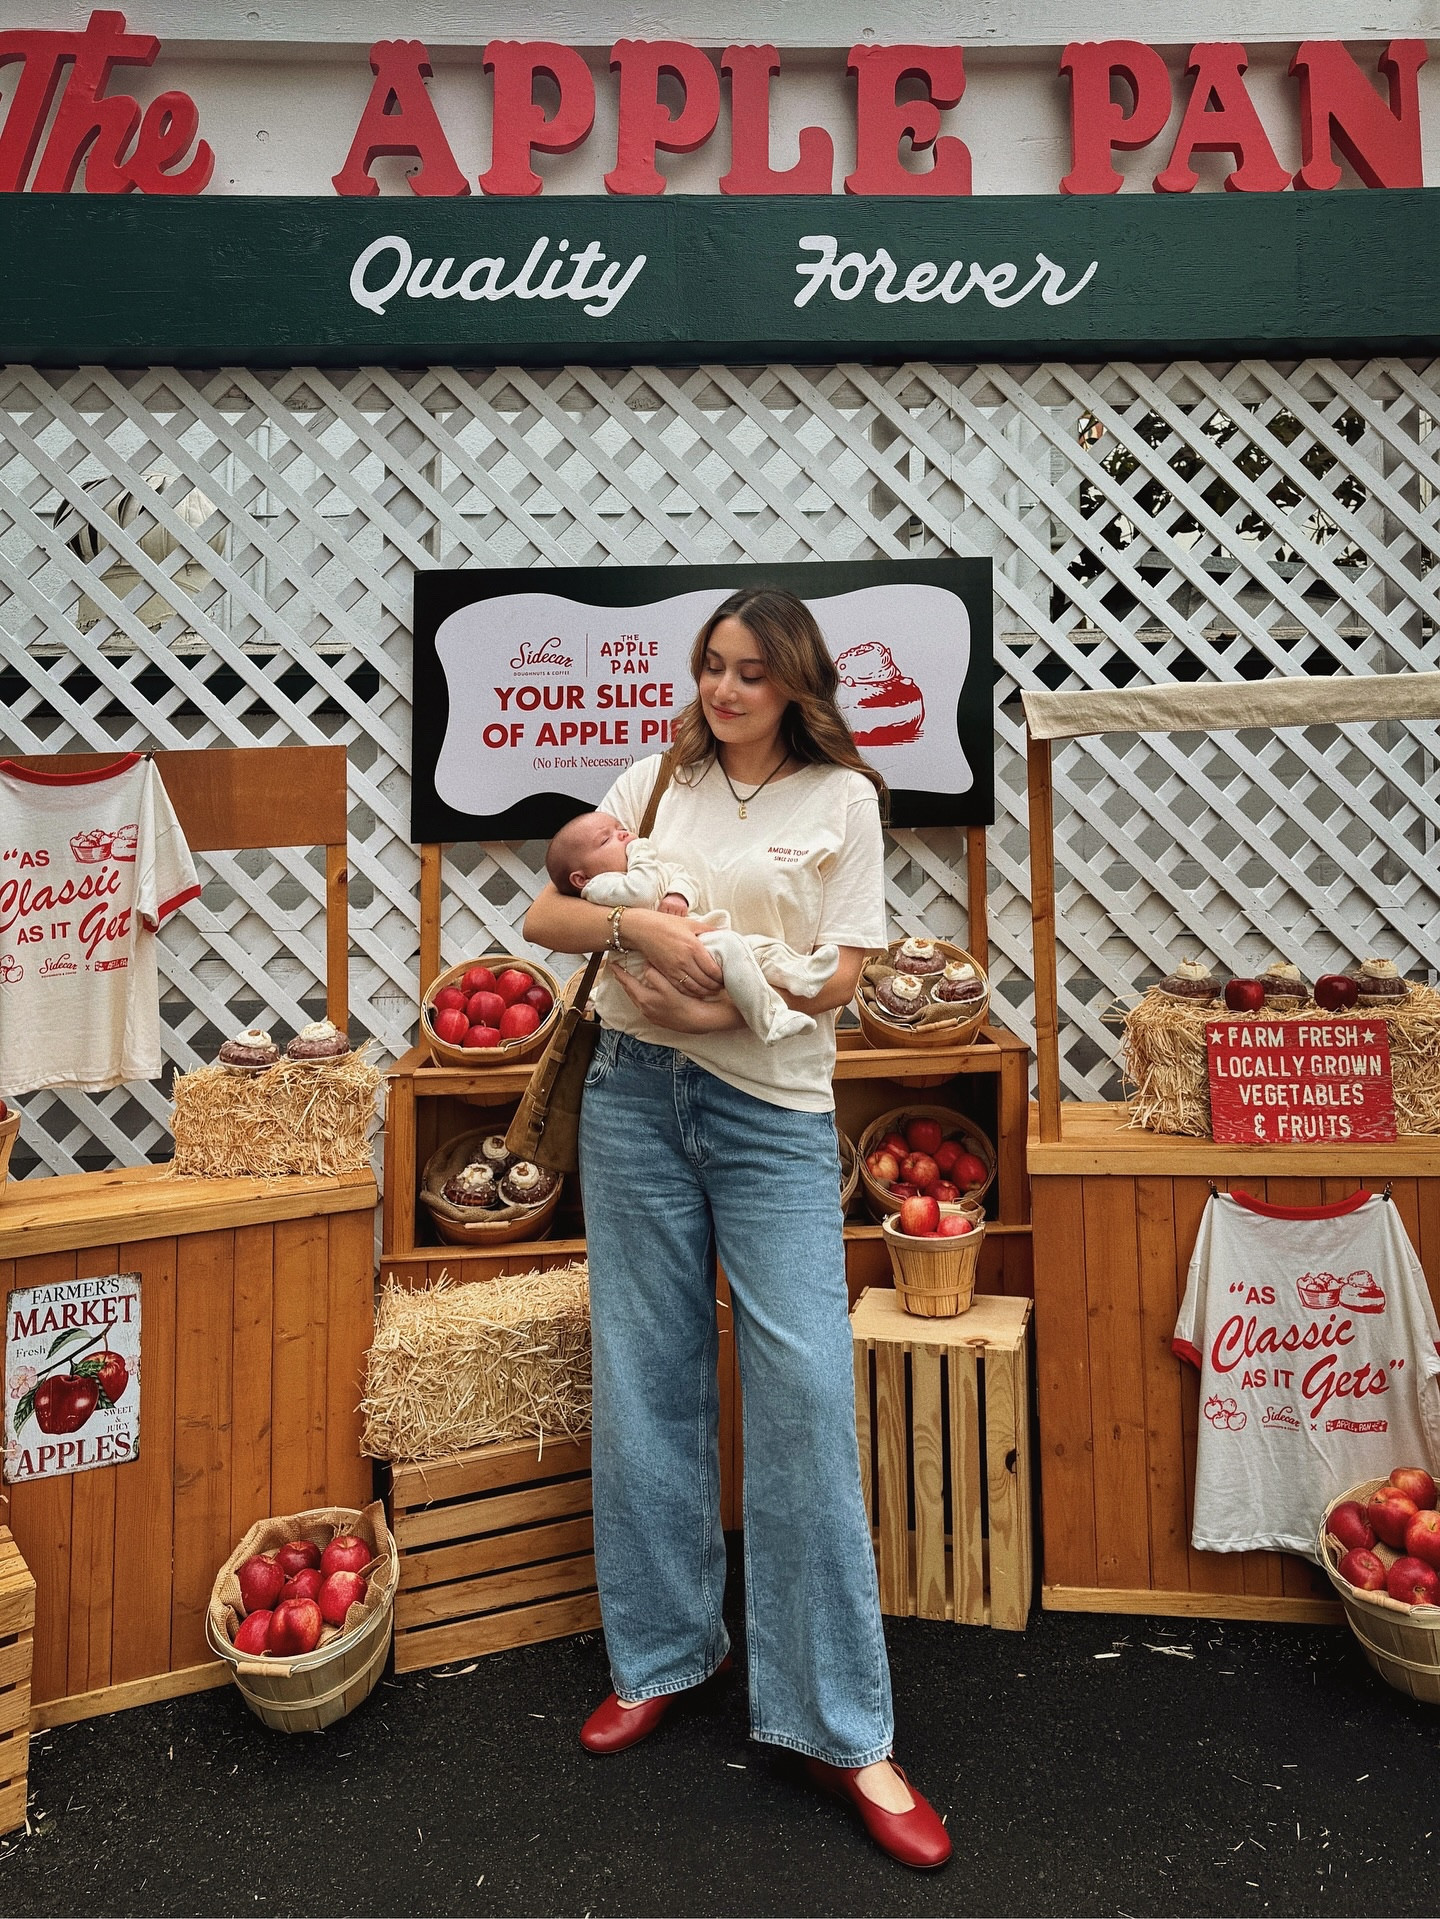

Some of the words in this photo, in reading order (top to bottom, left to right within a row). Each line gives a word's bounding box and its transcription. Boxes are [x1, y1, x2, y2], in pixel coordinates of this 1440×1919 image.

[0, 10, 215, 194] The
[332, 39, 972, 196] APPLE
[1058, 39, 1428, 195] PAN
[350, 236, 646, 317] Quality
[794, 235, 1098, 308] Forever
[510, 637, 573, 669] Sidecar
[601, 641, 658, 657] APPLE
[611, 659, 649, 674] PAN
[494, 686, 585, 711] YOUR
[597, 683, 673, 708] SLICE
[483, 723, 524, 748] OF
[535, 721, 629, 746] APPLE
[533, 756, 551, 770] (No
[554, 756, 577, 768] Fork
[580, 754, 634, 770] Necessary)
[768, 846, 792, 855] AMOUR
[17, 925, 44, 945] AS
[51, 921, 71, 940] IT
[78, 902, 131, 960] Get
[39, 953, 77, 974] Sidecar
[1227, 1026, 1284, 1048] FARM
[1298, 1025, 1358, 1048] FRESH
[1216, 1055, 1305, 1078] LOCALLY
[1311, 1054, 1382, 1077] GROWN
[1238, 1083, 1365, 1107] VEGETABLES
[1277, 1115, 1351, 1138] FRUITS
[31, 1279, 120, 1305] FARMER'S
[11, 1293, 137, 1342] MARKET
[15, 1345, 46, 1358] Fresh
[1211, 1314, 1355, 1373] Classic
[1241, 1369, 1267, 1390] AS
[1273, 1369, 1294, 1389] IT
[103, 1405, 133, 1417] SWEET
[1262, 1406, 1300, 1427] Sidecar
[106, 1422, 130, 1433] JUICY
[14, 1432, 131, 1477] APPLES
